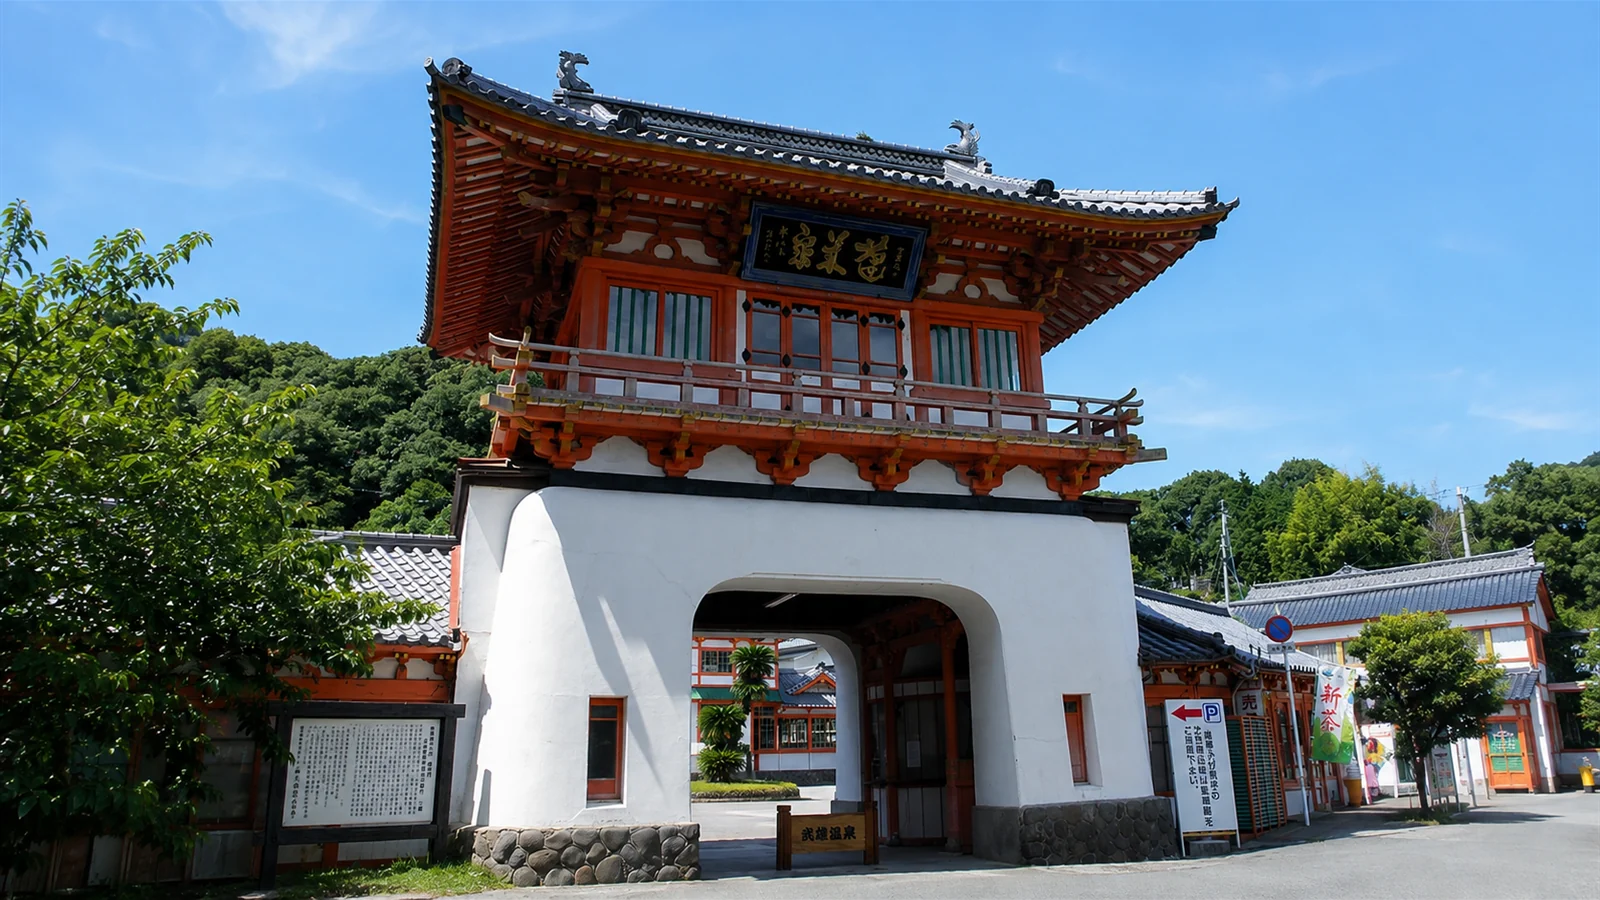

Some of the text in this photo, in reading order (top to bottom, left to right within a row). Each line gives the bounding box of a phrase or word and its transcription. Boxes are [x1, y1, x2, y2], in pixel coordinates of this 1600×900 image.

[1205, 705, 1218, 721] P
[1242, 695, 1258, 716] 売
[1320, 683, 1342, 733] 新茶
[801, 825, 856, 841] 武雄温泉
